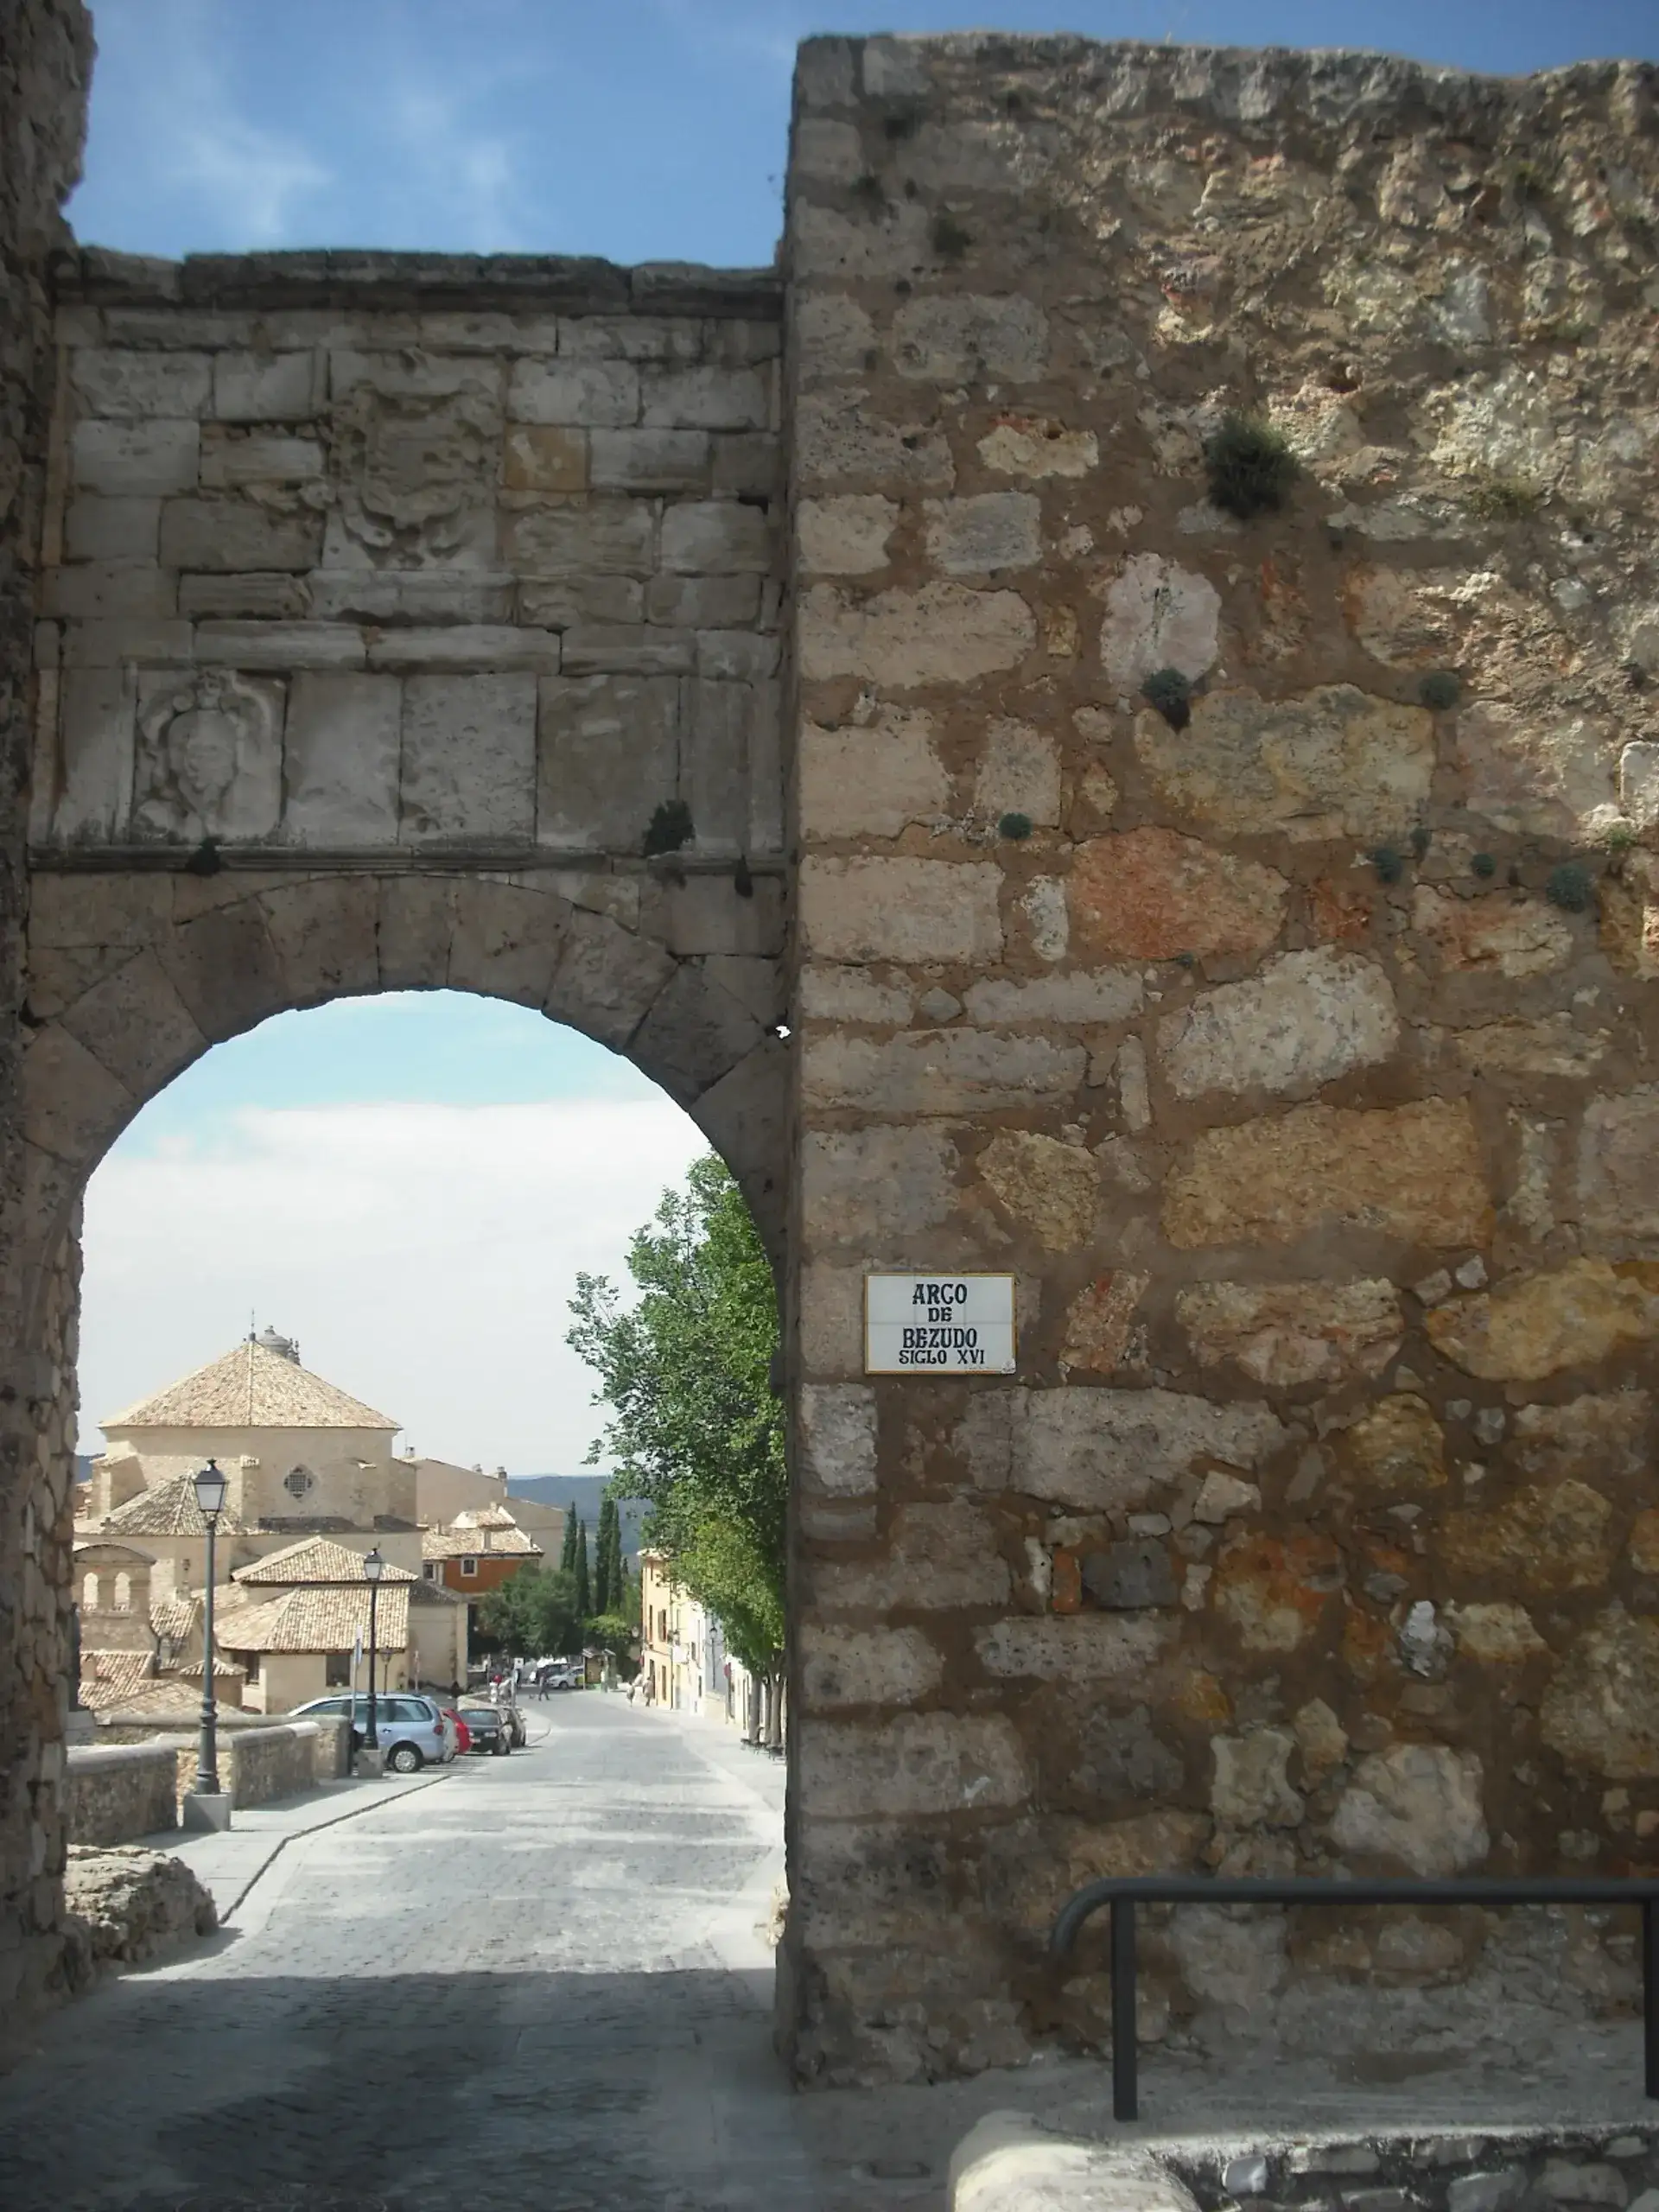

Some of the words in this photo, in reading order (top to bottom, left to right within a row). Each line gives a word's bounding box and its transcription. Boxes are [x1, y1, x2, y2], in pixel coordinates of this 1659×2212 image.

[912, 1283, 968, 1305] ARCO
[928, 1306, 953, 1322] DE
[903, 1327, 977, 1349] BEZUDO
[899, 1350, 947, 1364] SIGLO
[957, 1350, 985, 1364] XVI
